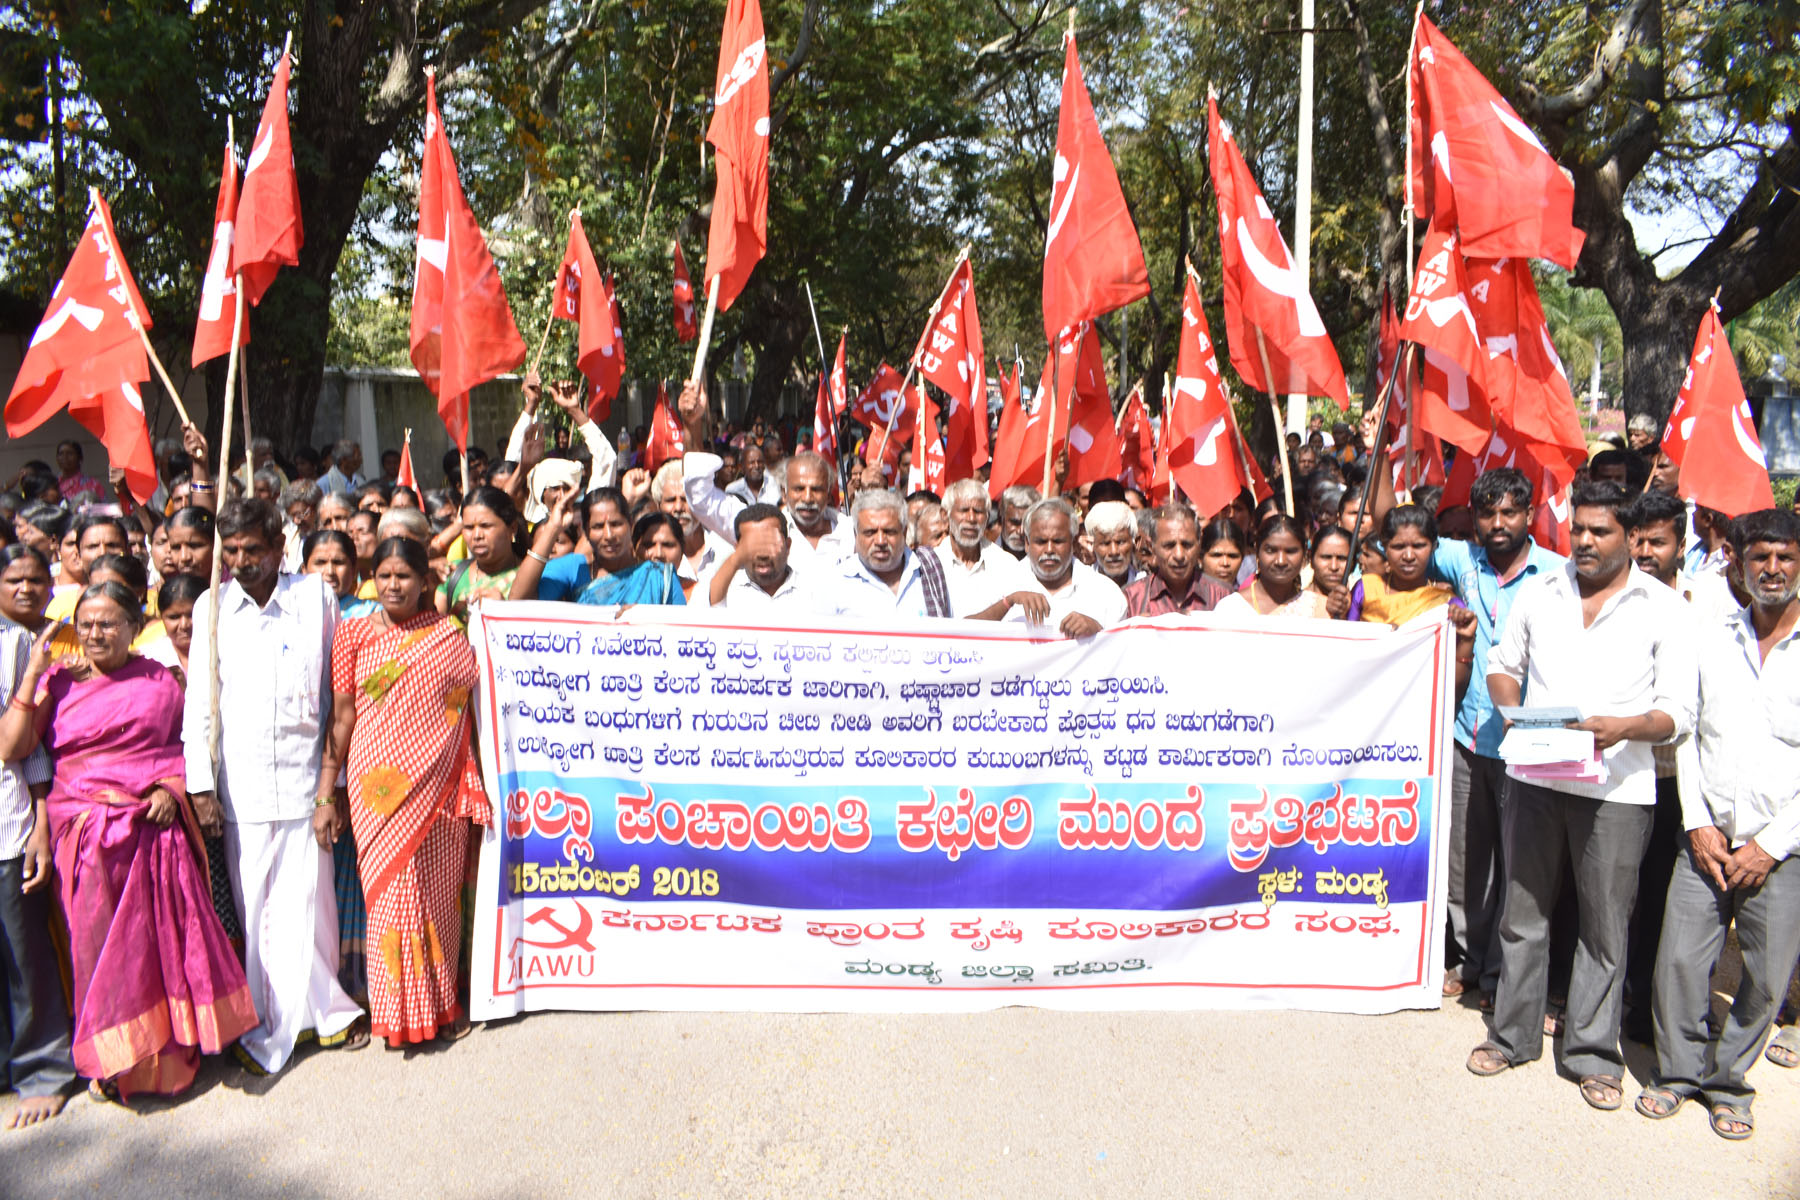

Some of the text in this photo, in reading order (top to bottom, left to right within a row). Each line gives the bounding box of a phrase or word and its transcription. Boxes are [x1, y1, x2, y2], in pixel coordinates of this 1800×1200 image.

[506, 631, 582, 654] ಬಡವರಿಗೆ
[592, 632, 667, 658] ನಿವೇಶನ,
[678, 636, 716, 670] ಹಕ್ಕು
[727, 638, 762, 669] ಪತ್ರ,
[601, 673, 643, 701] ಖಾತ್ರಿ
[653, 670, 700, 694] ಕೆಲಸ
[711, 672, 792, 696] ಸಮರ್ಪಕ
[803, 679, 889, 701] ಜಾರಿಗಾಗಿ,
[990, 674, 1072, 709] ತಡೆಗಟ್ಟಲು
[585, 707, 682, 732] ಬಂಧುಗಳಿಗೆ
[692, 708, 768, 731] ಗುರುತಿನ
[779, 712, 820, 732] ಚೀಟಿ
[830, 712, 872, 732] ನೀಡಿ
[952, 708, 1048, 732] ಬರಬೇಕಾದ
[1126, 707, 1155, 734] ಧನ
[1165, 708, 1275, 733] ಬಿಡುಗಡೆಗಾಗಿ
[604, 746, 643, 772] ಖಾತ್ರಿ
[654, 743, 700, 766] ಕೆಲಸ
[711, 746, 844, 777] ನಿರ್ವಹಿಸುತ್ತಿರುವ
[855, 747, 957, 768] ಕೂಲಿಕಾರರ
[967, 745, 1093, 776] ಕುಟುಂಬಗಳನ್ನು
[1104, 744, 1147, 778] ಕಟ್ಟಡ
[1158, 745, 1272, 767] ಕಾರ್ಮಿಕರಾಗಿ
[505, 781, 1419, 871] ಜಿಲ್ಲಾ ಪಂಚಾಯಿತಿ ಕಛೇರಿ ಮುಂದೆ ಪ್ರತಿಭಟನೆ
[653, 866, 720, 896] 2018
[1315, 865, 1389, 909] ಮಂಡ್ಯ
[601, 908, 782, 933] ಕರ್ನಾಟಕ
[807, 916, 925, 946] ಪ್ರಾಂತ
[950, 916, 1023, 951] ಕೃಷಿ
[1048, 907, 1270, 941] ಕೂಲಿಕಾರರ
[508, 955, 594, 984] AIAWU
[845, 956, 1153, 985] ಮಂಡ್ಯ ಜಿಲ್ಲಾ ಸಮಿತಿ.
